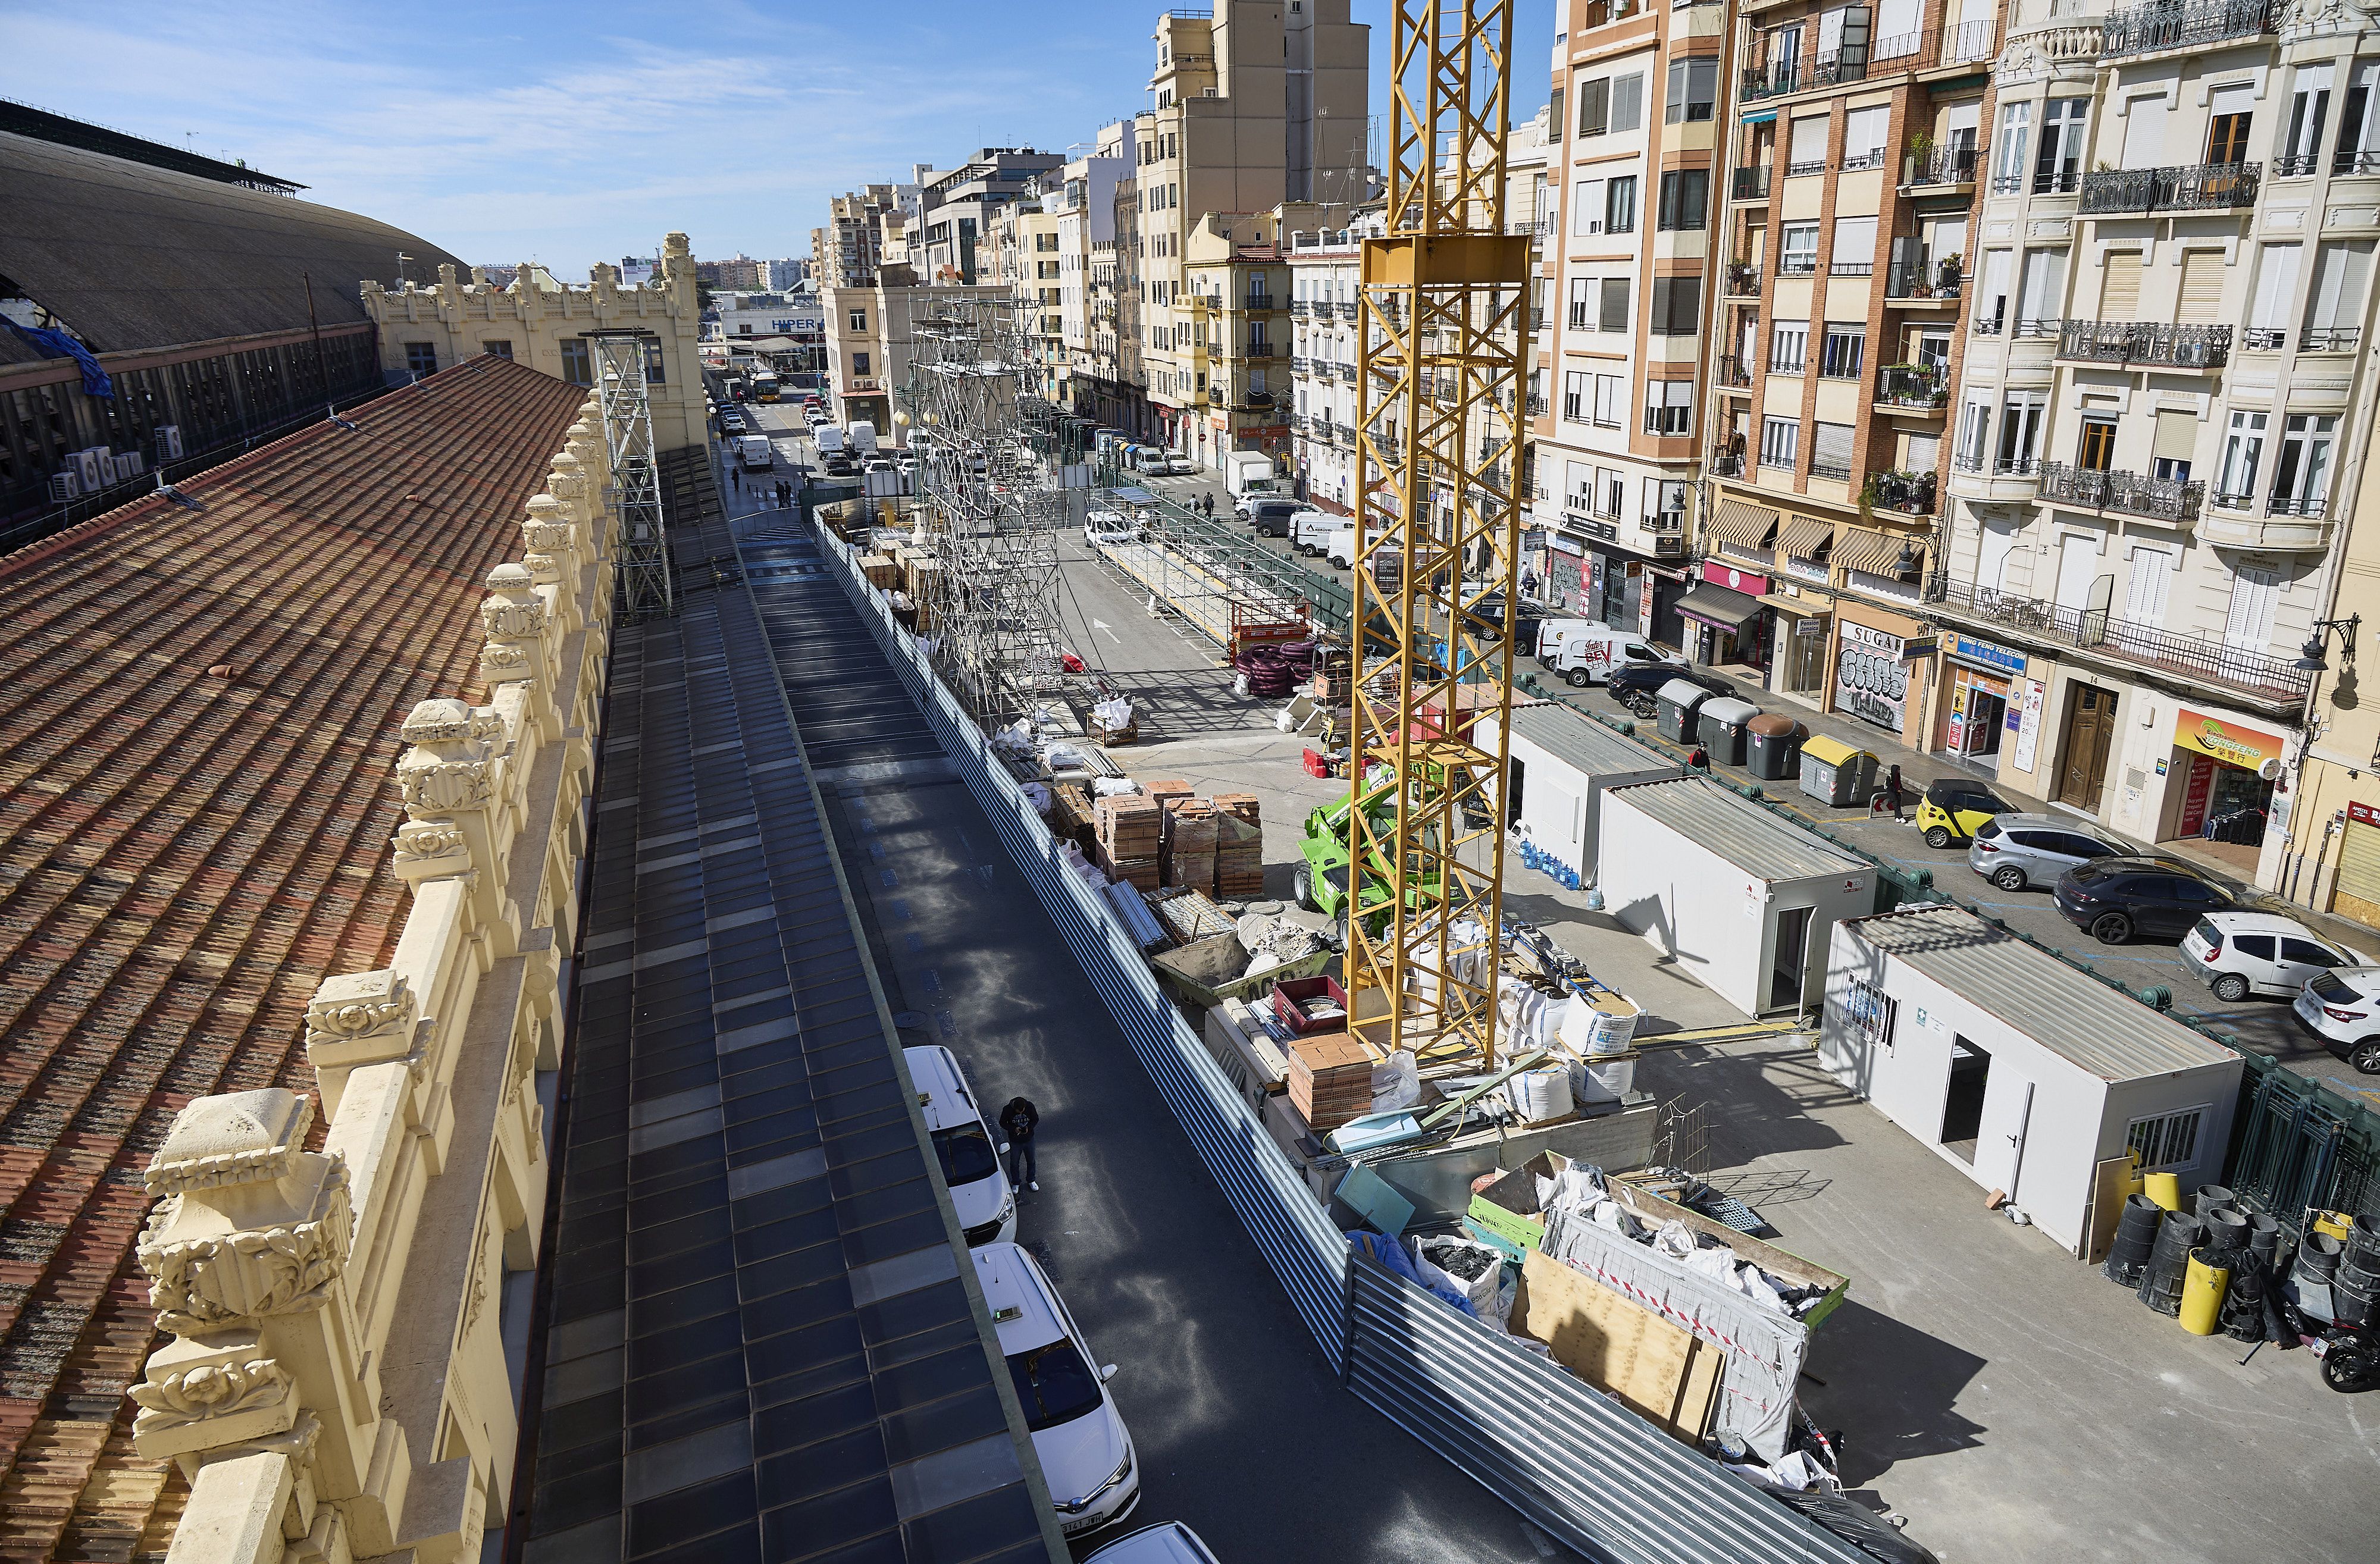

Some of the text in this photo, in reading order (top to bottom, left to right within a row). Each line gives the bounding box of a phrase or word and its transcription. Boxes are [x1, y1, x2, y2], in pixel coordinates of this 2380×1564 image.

[772, 319, 815, 329] HIPER
[1807, 568, 1826, 579] JAMAICA
[1584, 639, 1605, 651] Inter
[1959, 636, 1977, 645] YONG
[1978, 642, 1994, 651] FENG
[1996, 647, 2026, 660] TELECOM
[1957, 651, 1982, 662] ACCESORIOS
[2090, 676, 2097, 684] 14
[2207, 729, 2236, 742] Electronic
[2206, 735, 2260, 757] YONGFENG
[2217, 747, 2246, 763] 榮豐行
[2353, 806, 2368, 814] AMSTEL
[1062, 1515, 1101, 1532] 3141 JWH
